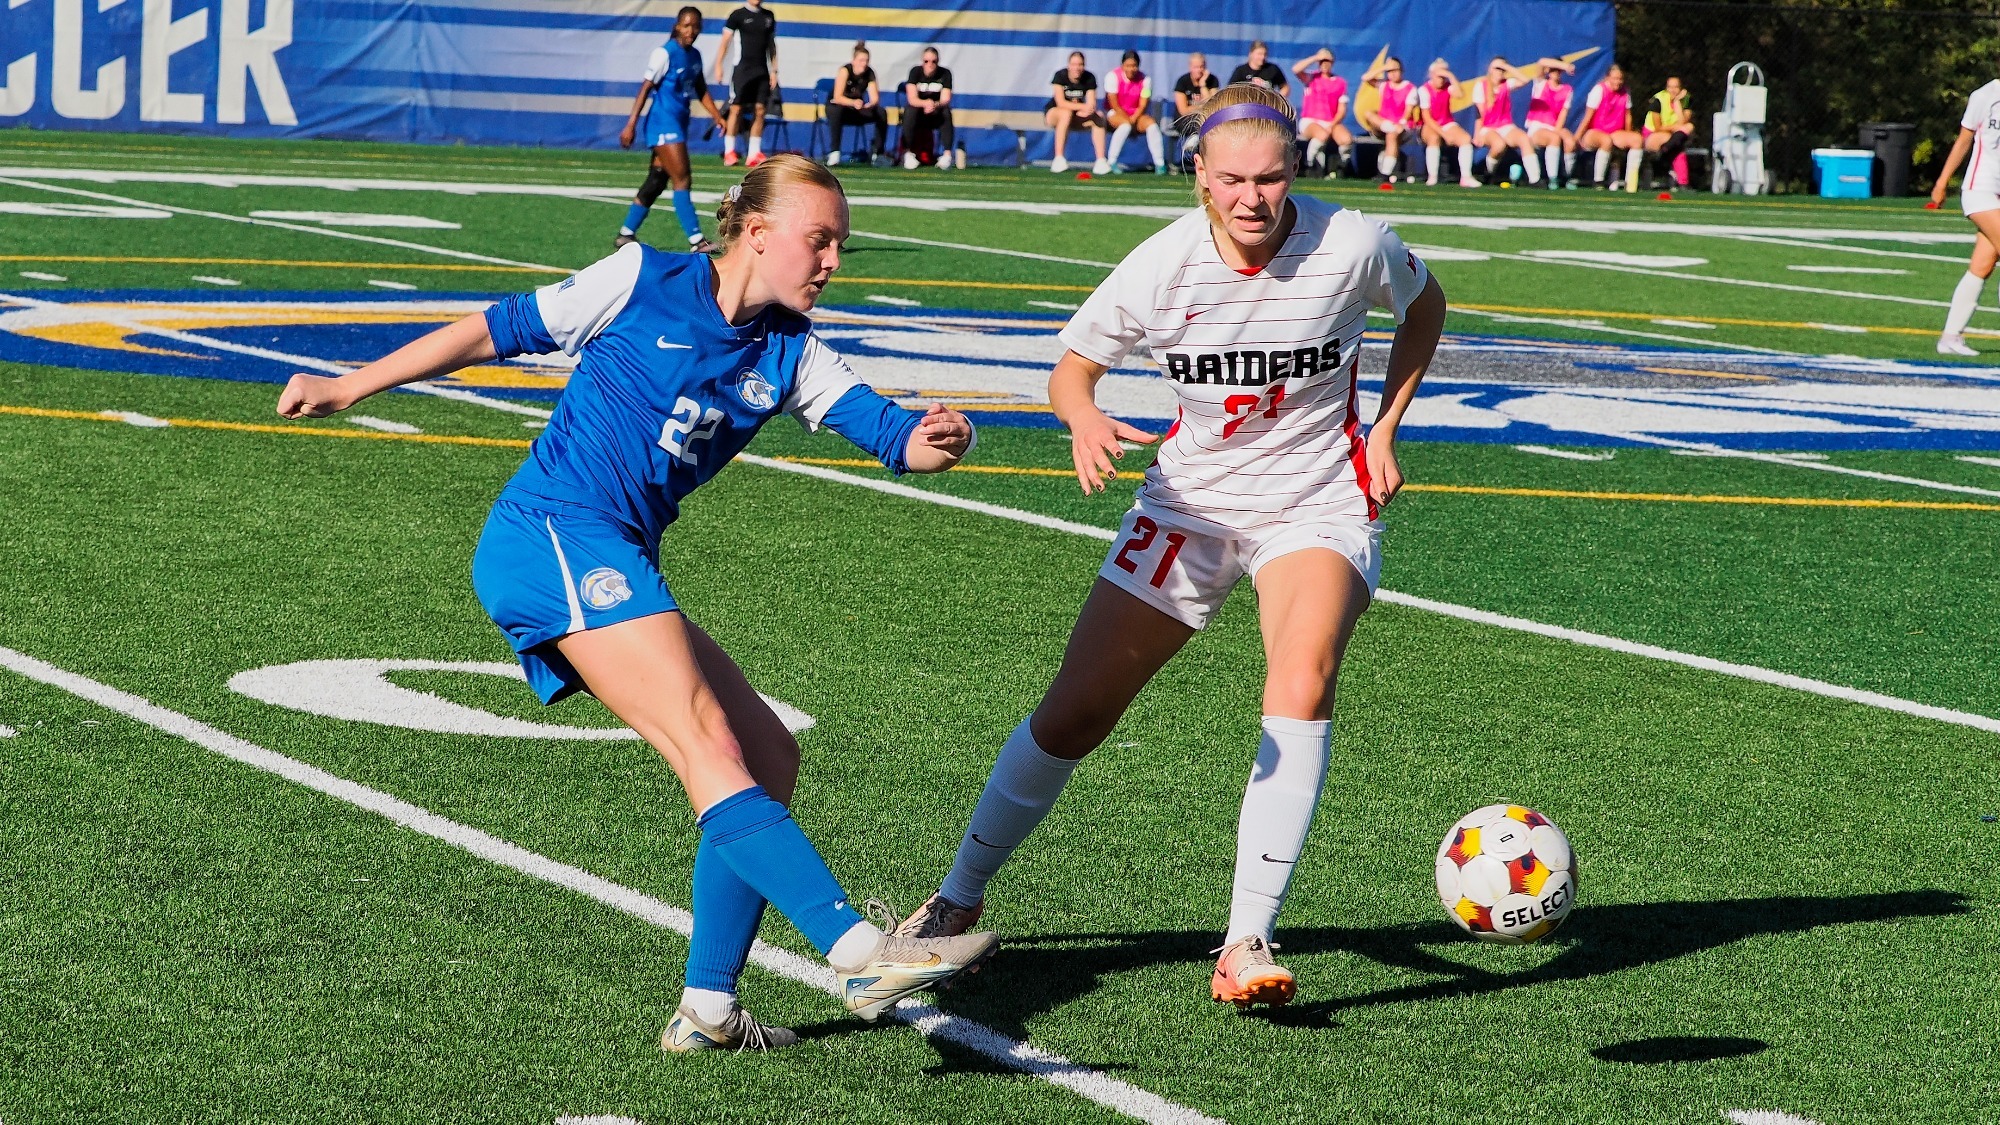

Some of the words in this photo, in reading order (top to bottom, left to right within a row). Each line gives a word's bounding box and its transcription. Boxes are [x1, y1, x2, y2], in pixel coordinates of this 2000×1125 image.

[1165, 338, 1341, 386] RAIDERS
[657, 396, 725, 466] 22
[1222, 384, 1285, 440] 21
[1113, 515, 1187, 589] 21
[1502, 881, 1569, 928] SELECT
